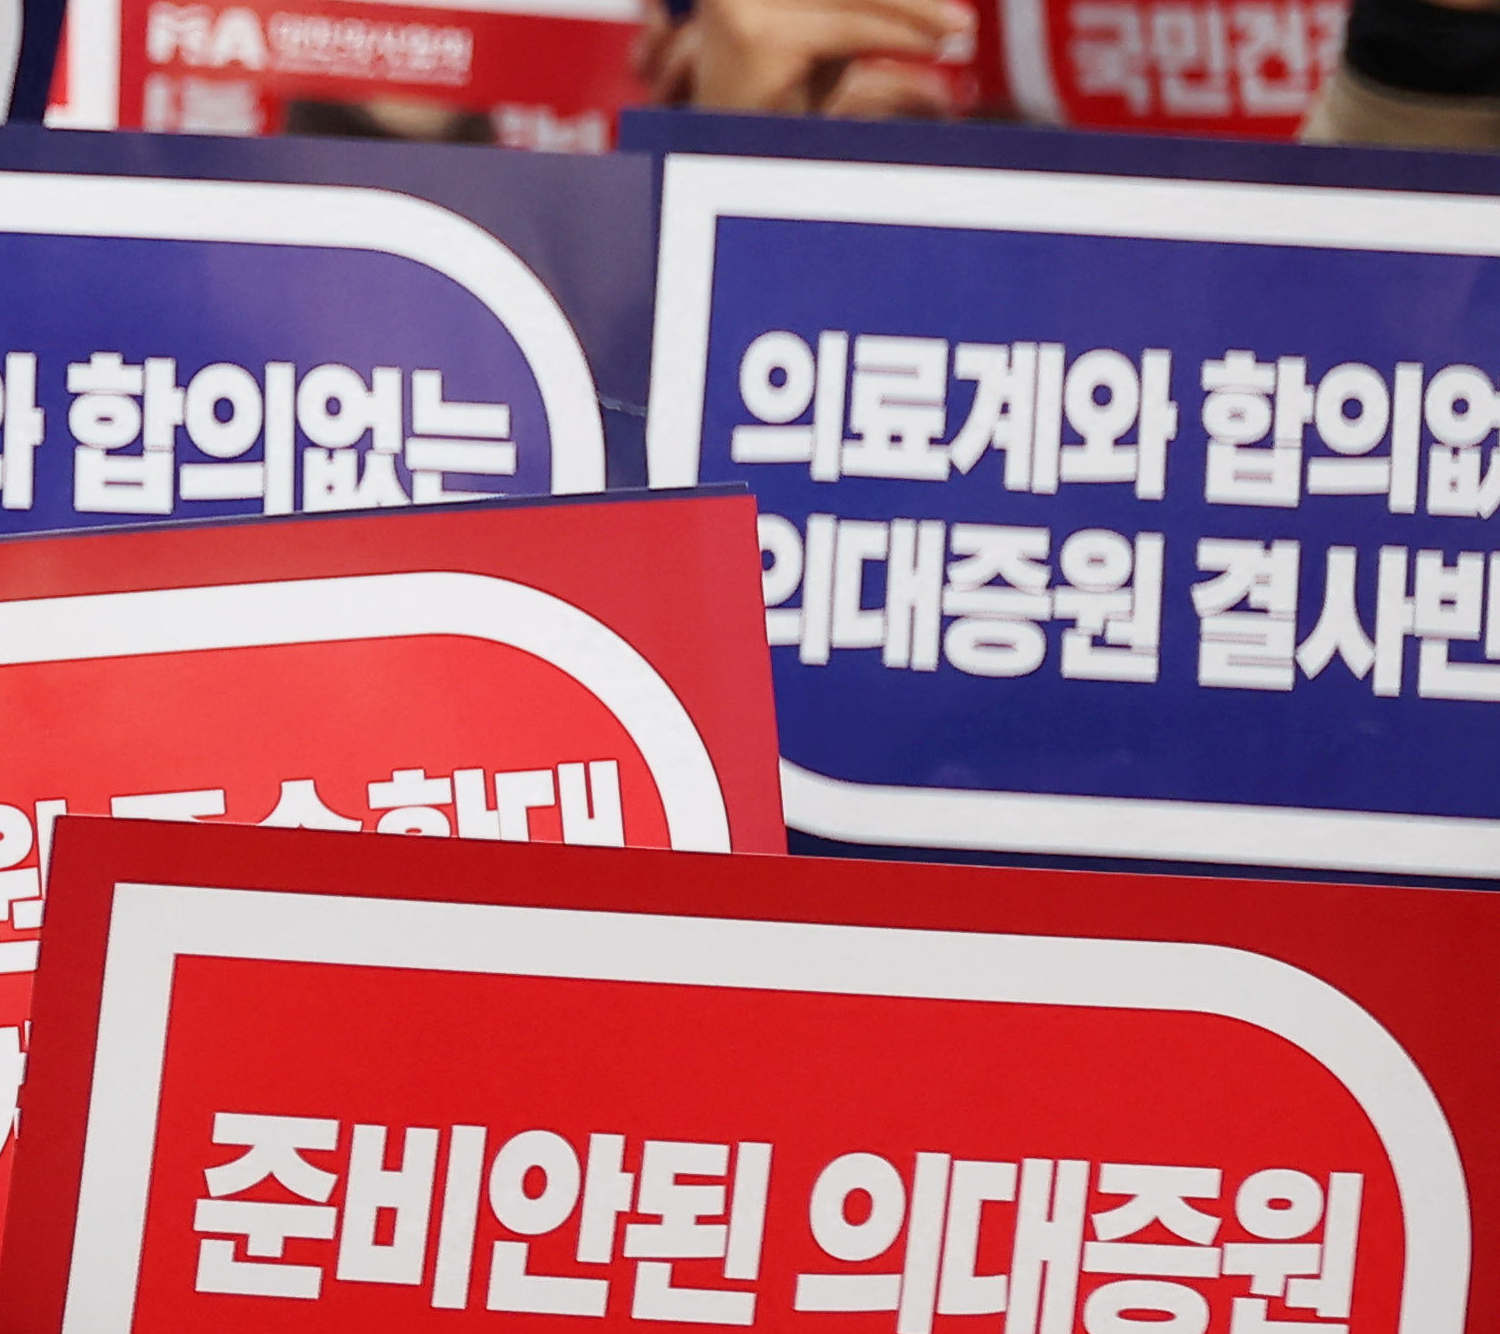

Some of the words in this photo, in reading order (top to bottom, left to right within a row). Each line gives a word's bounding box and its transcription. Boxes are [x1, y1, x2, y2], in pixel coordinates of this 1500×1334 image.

[66, 349, 516, 515] 합의없는
[731, 330, 1177, 501] 의료계와
[761, 514, 1163, 682] 의대증원
[193, 1111, 773, 1327] 준비안된
